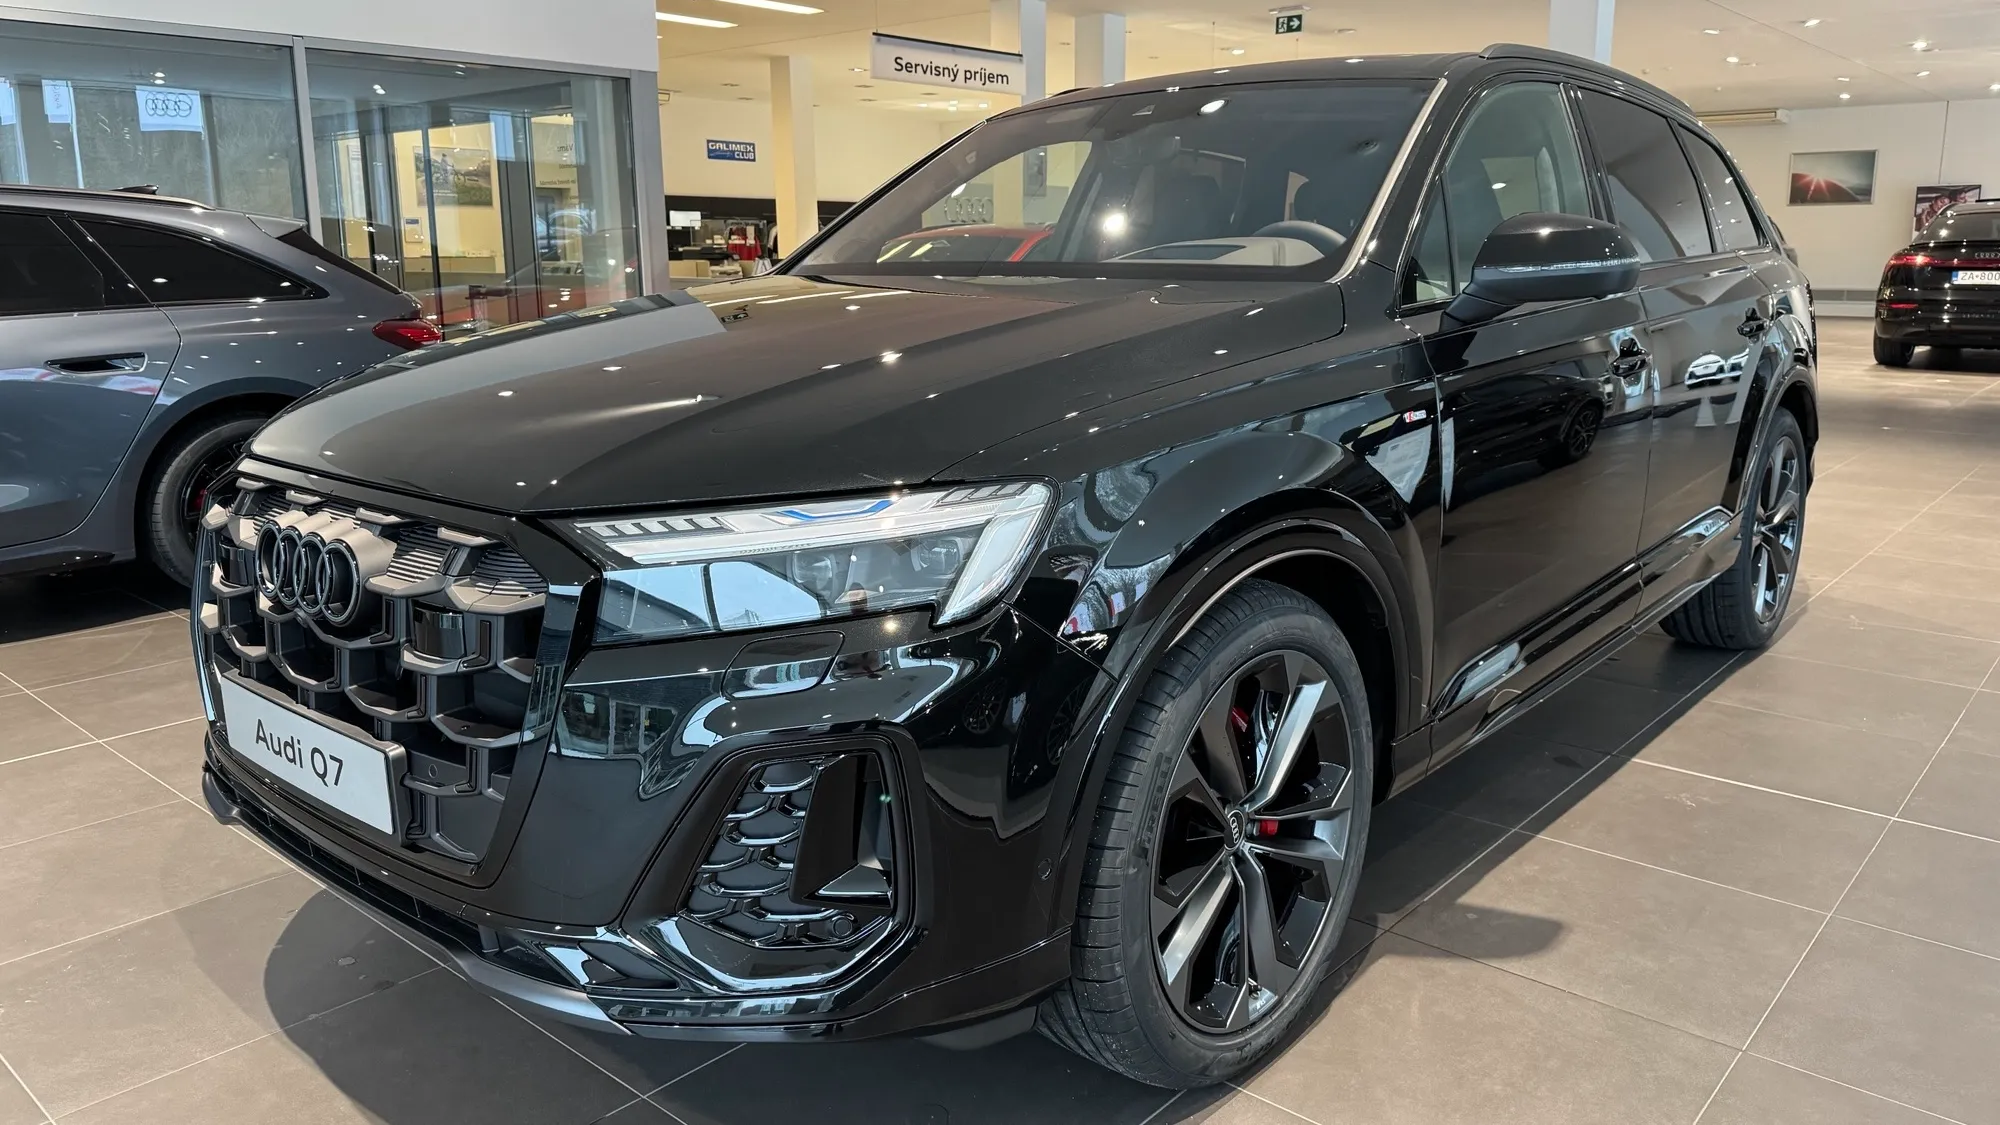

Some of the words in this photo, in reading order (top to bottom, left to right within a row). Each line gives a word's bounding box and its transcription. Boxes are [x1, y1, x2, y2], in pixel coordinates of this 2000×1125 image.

[894, 56, 959, 82] Servisný
[964, 67, 1010, 86] príjem
[708, 142, 754, 152] GALIMEX
[734, 151, 755, 160] CLUB
[256, 718, 304, 769] Audi
[310, 746, 344, 788] Q7
